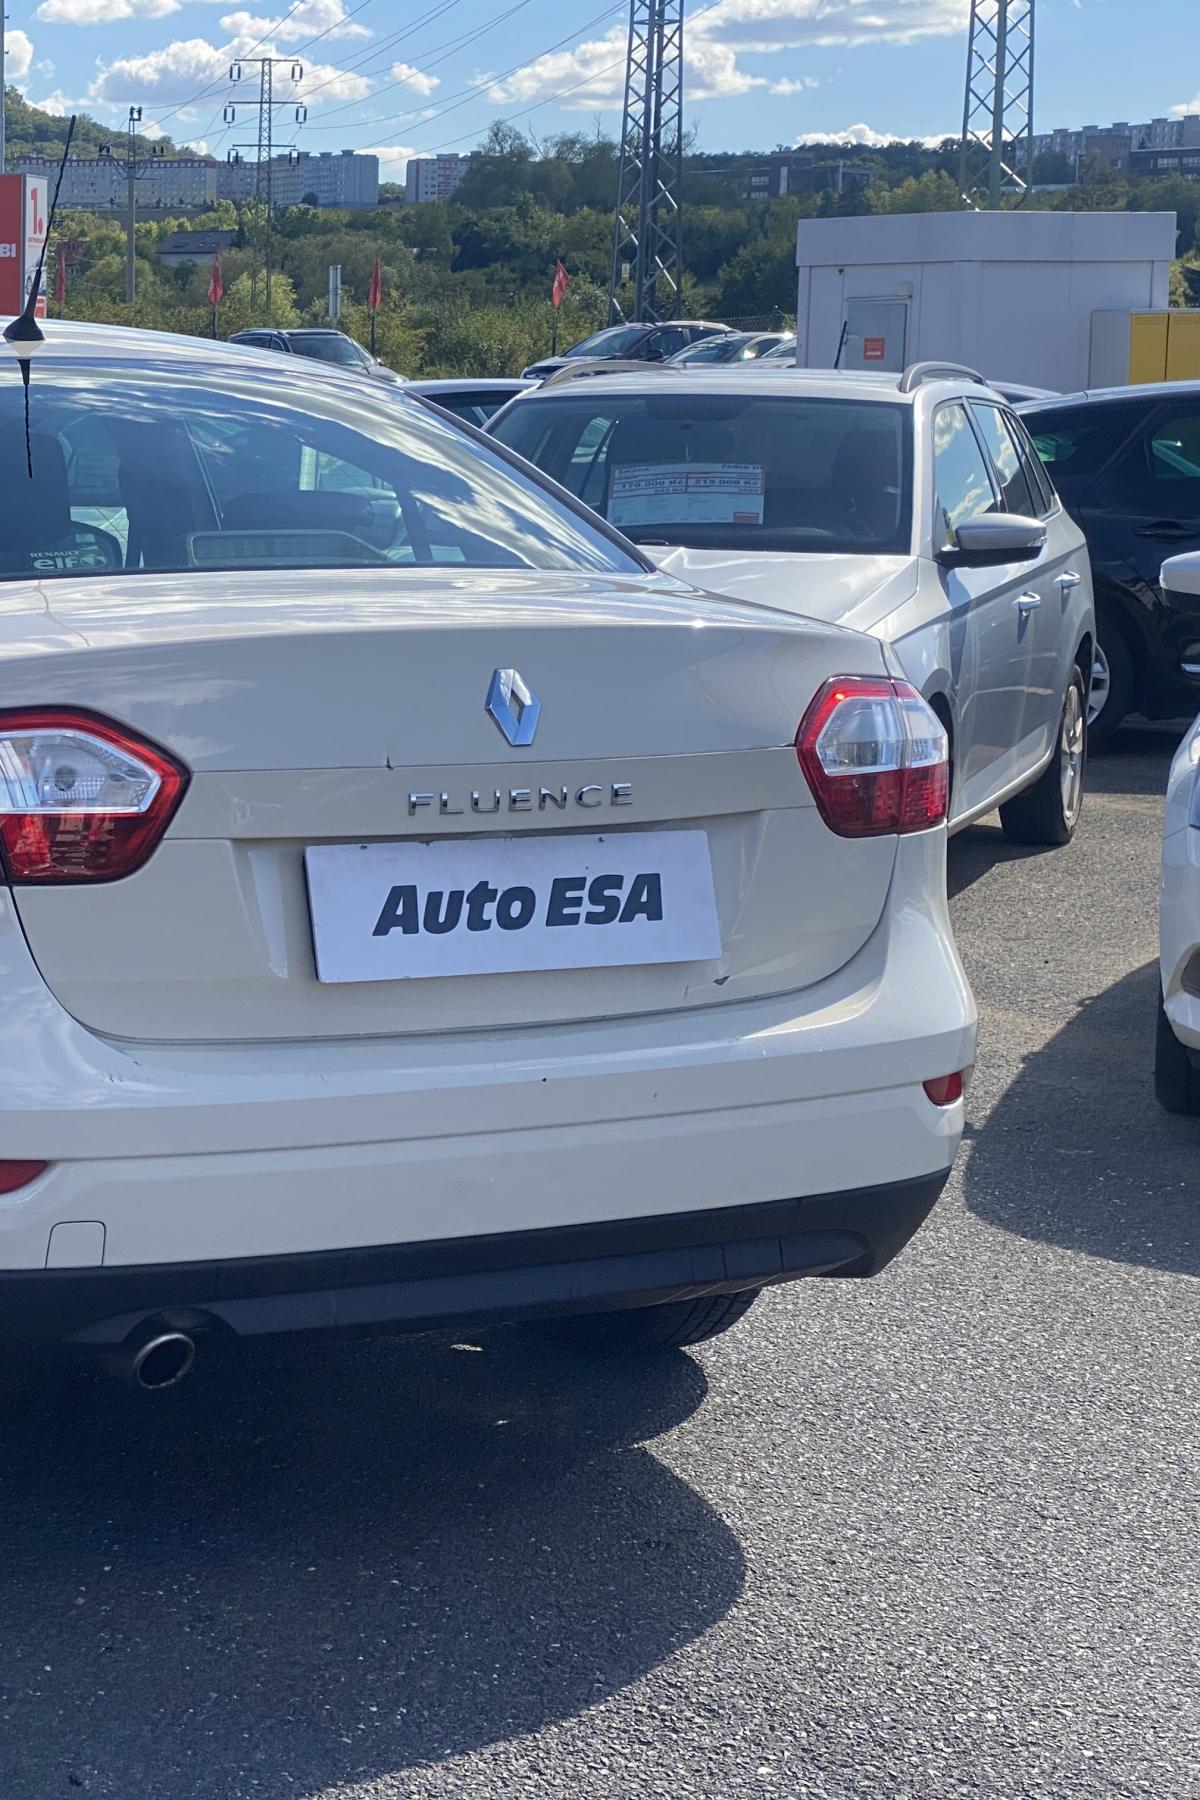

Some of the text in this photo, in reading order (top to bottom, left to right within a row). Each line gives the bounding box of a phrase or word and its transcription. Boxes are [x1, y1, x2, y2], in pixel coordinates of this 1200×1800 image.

[29, 550, 80, 558] RENAULT
[407, 782, 635, 816] FLUENCE
[372, 872, 664, 937] Auto ESA
